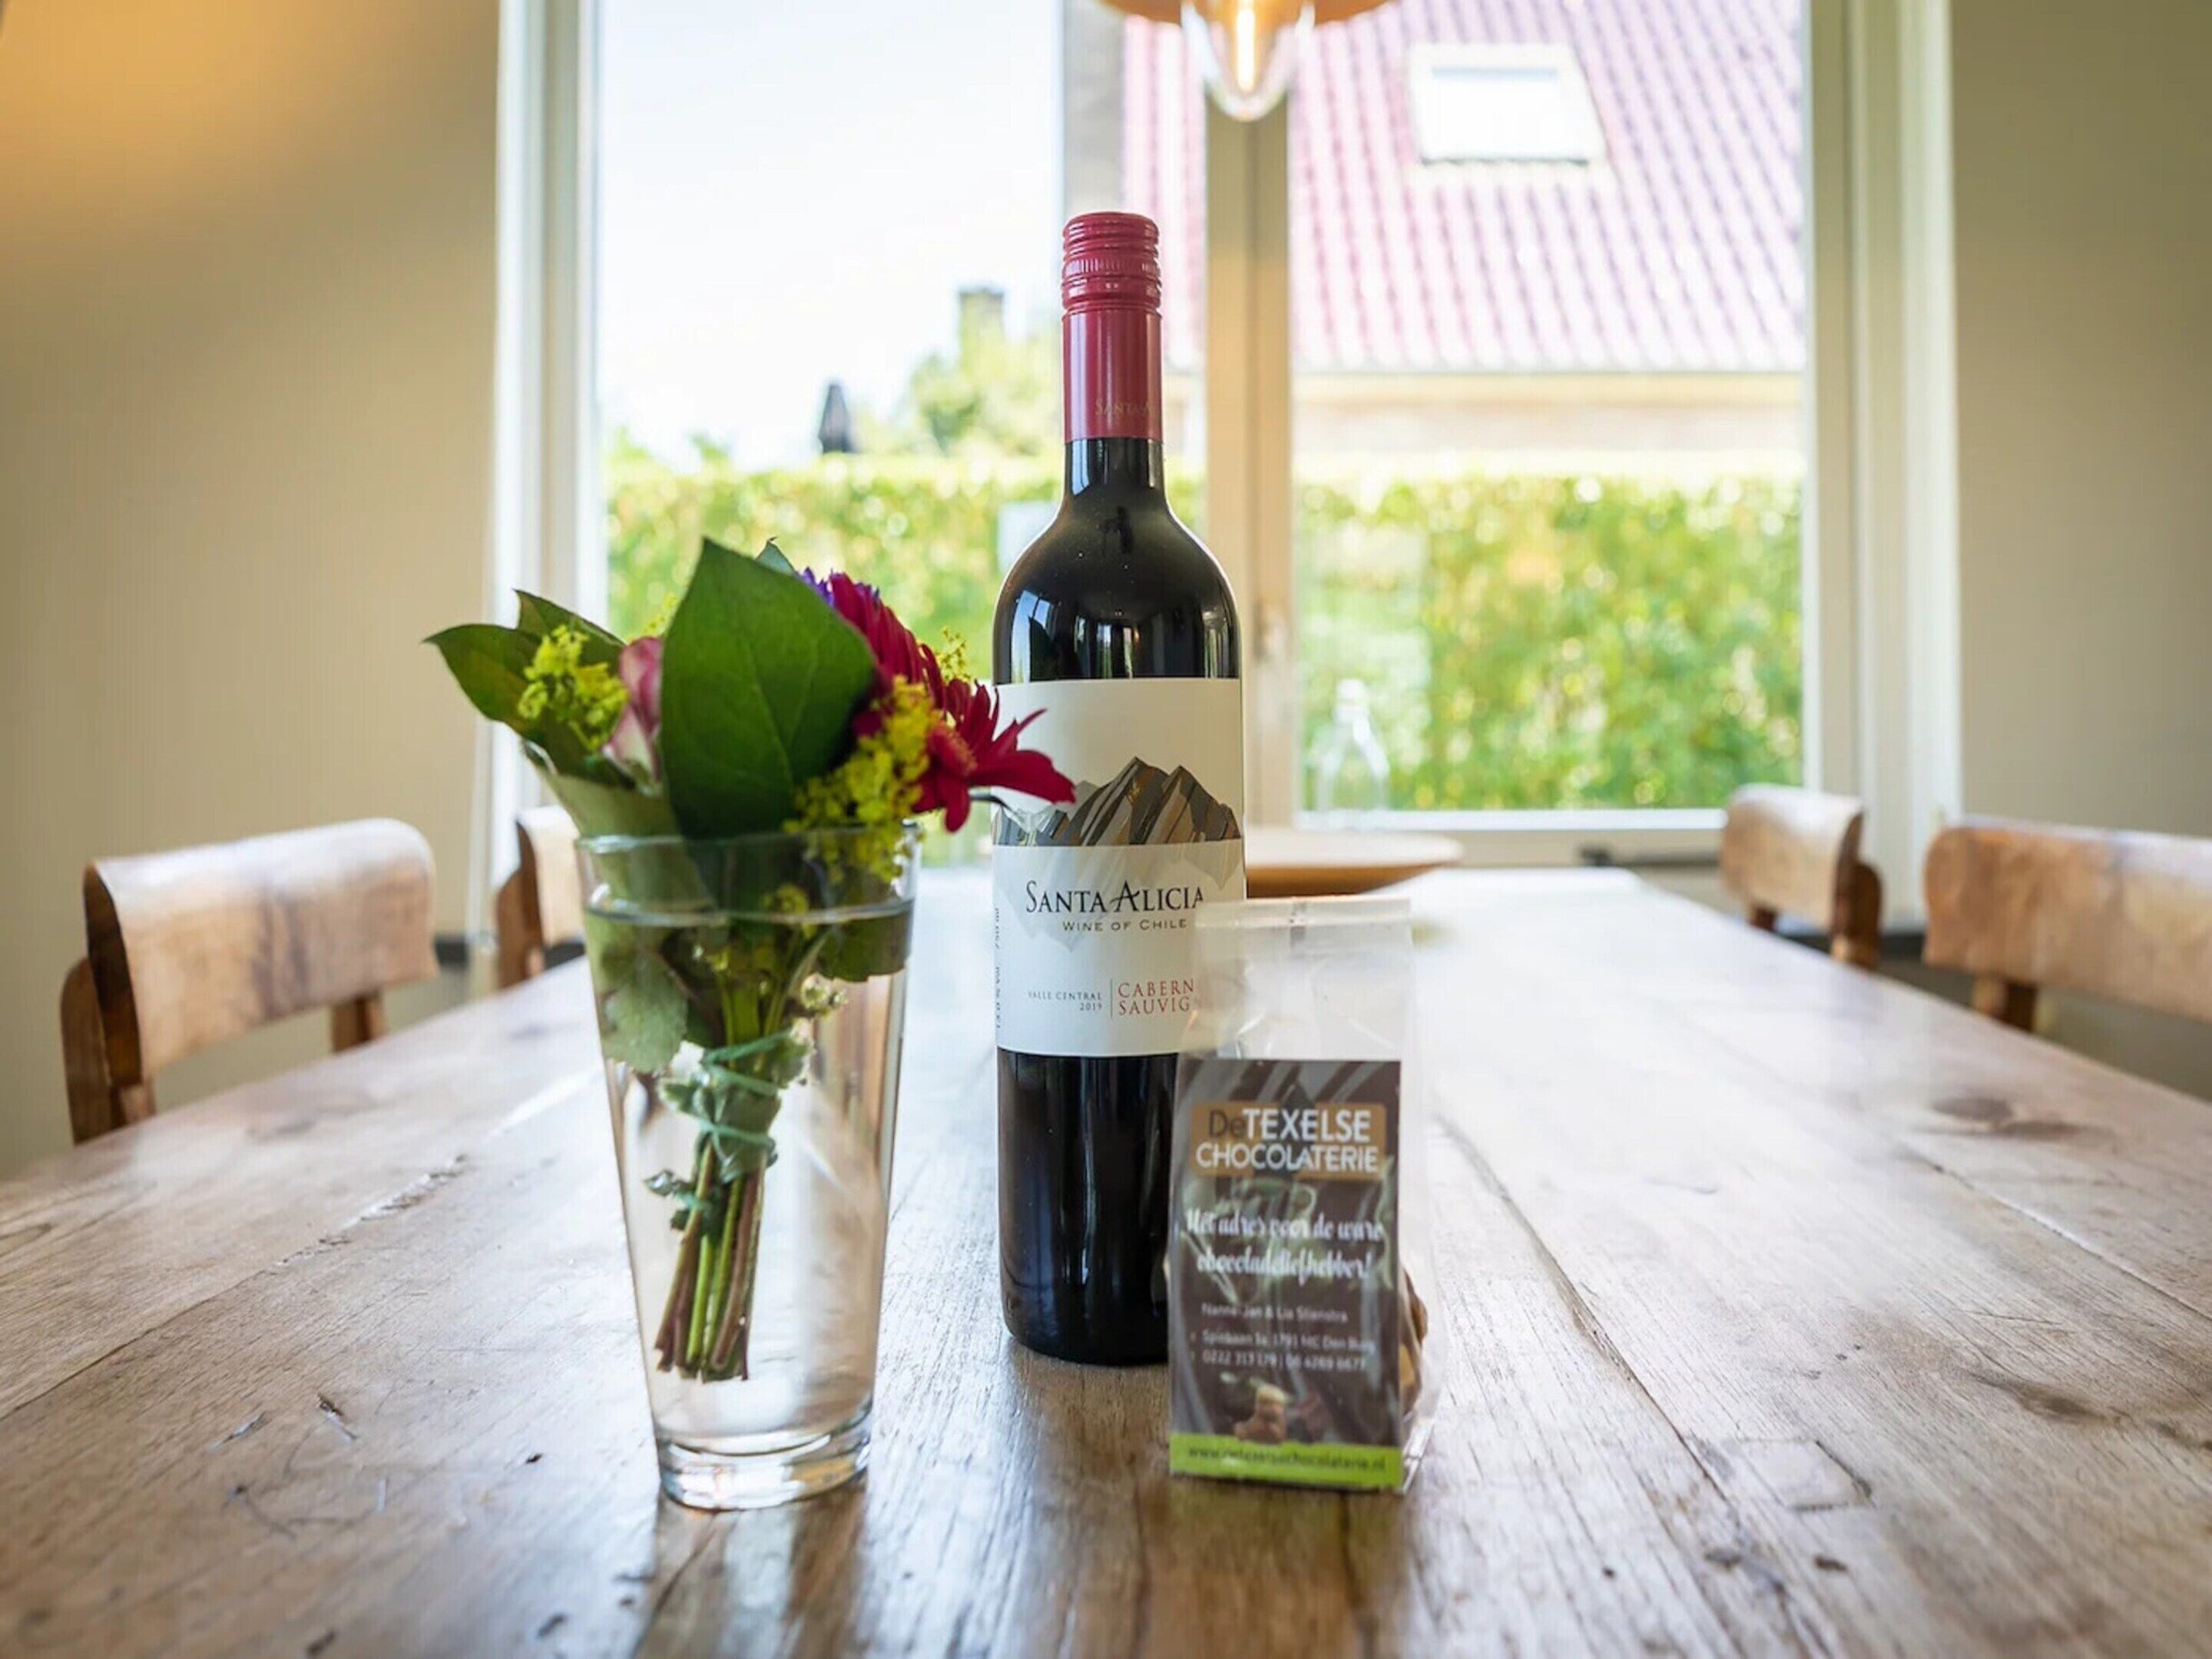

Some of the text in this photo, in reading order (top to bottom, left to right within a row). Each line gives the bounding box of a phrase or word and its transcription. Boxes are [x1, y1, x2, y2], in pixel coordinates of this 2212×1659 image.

[1026, 880, 1204, 913] SANTA ALICIA
[1062, 919, 1187, 932] WINE OF CHILE
[1055, 991, 1102, 1001] CENTRAL
[1118, 979, 1194, 998] CABERN
[1079, 1002, 1103, 1012] 2019
[1118, 996, 1190, 1016] SAUVIG
[1243, 1109, 1372, 1142] TEXELSE
[1196, 1143, 1379, 1172] CHOCOLATERIE
